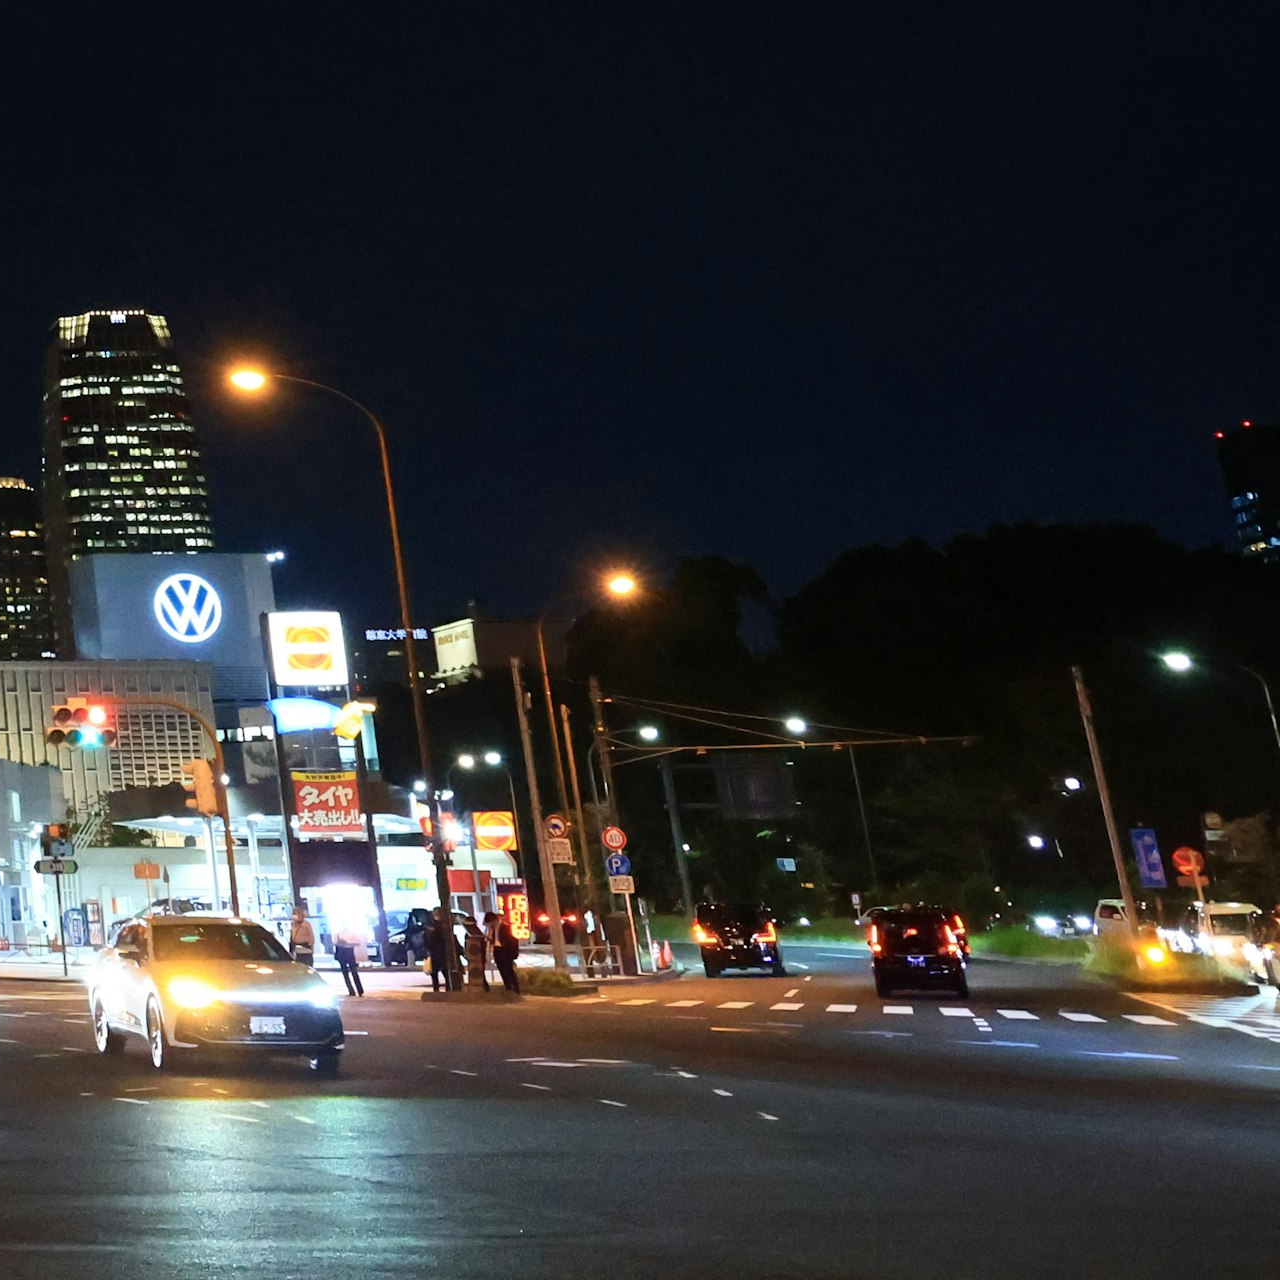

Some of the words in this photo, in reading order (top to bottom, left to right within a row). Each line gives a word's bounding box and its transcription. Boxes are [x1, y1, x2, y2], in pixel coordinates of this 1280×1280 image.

[299, 785, 354, 807] タイヤ
[298, 808, 360, 827] 大売出し!!
